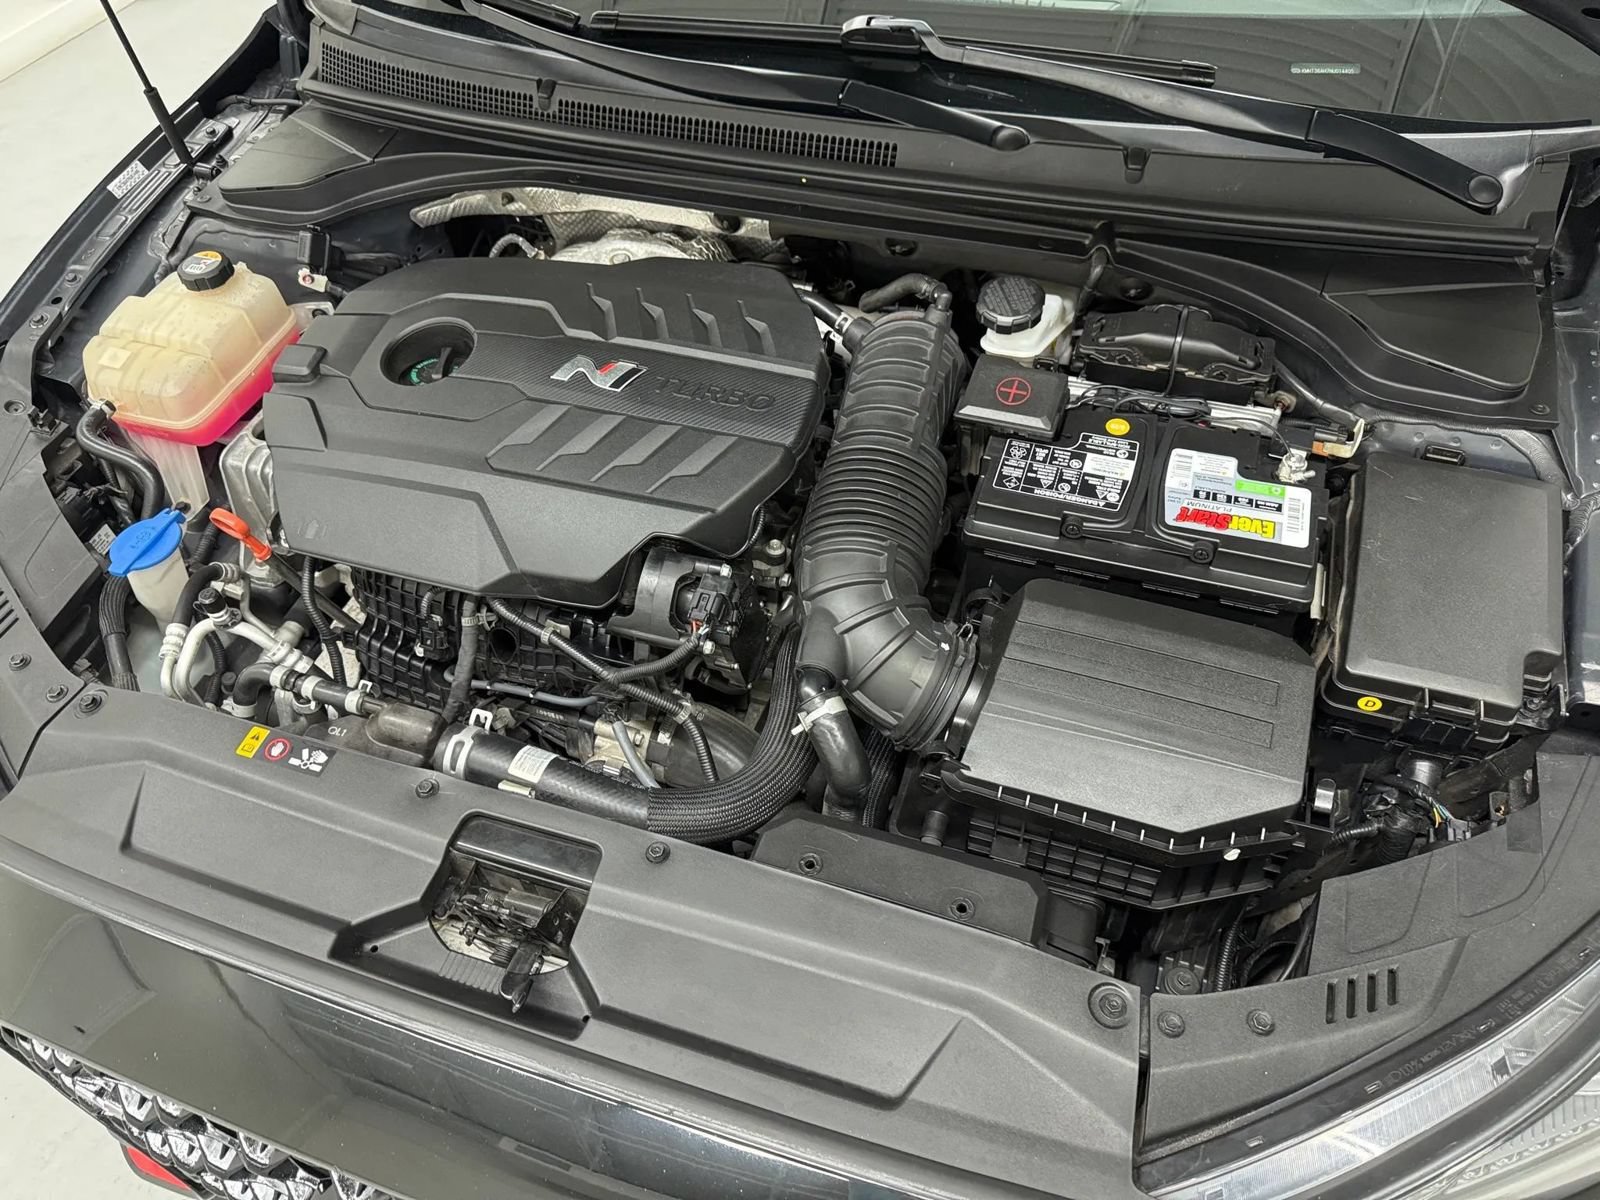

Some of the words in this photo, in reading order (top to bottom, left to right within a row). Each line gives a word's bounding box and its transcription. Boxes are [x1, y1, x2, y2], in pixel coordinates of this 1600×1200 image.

[655, 375, 776, 413] TURBO
[1186, 500, 1233, 512] PLATINUM
[1175, 506, 1276, 540] EverStart
[327, 726, 347, 737] QL1
